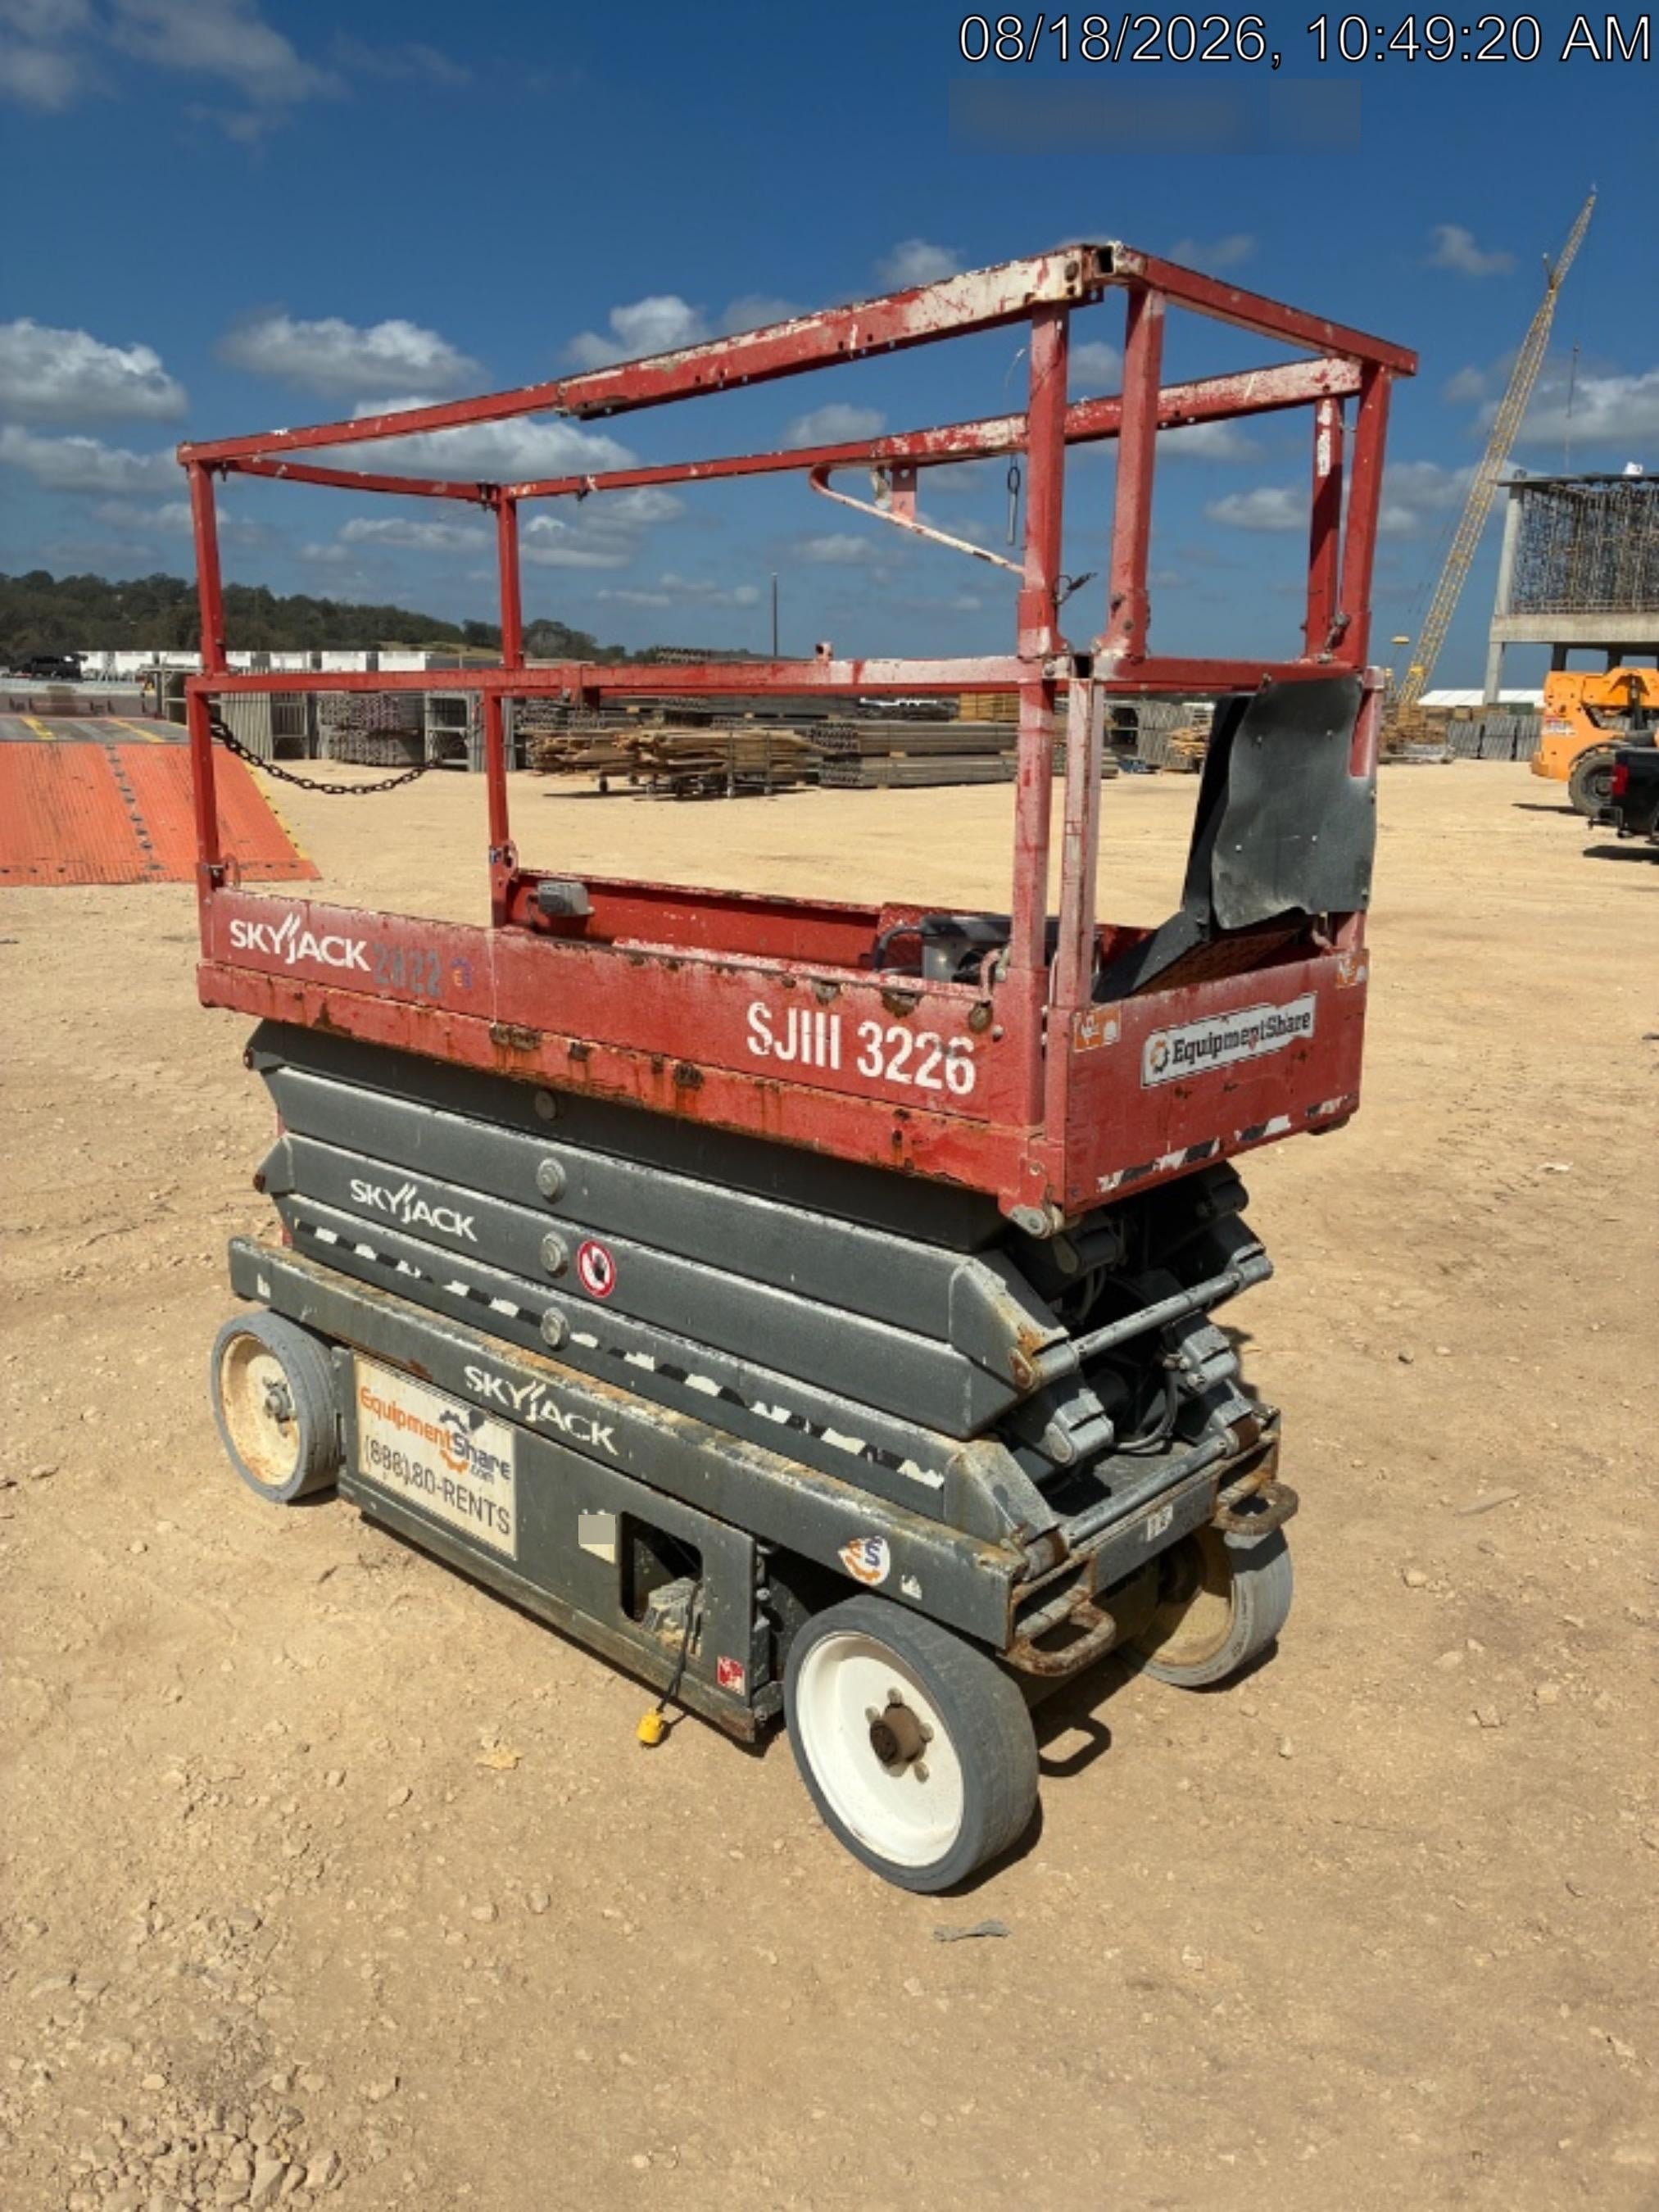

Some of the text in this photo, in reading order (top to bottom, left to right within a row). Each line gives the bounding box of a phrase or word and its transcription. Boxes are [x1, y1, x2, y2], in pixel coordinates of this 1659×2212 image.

[229, 912, 371, 972] SKYJACK
[856, 1021, 977, 1095] 3226
[1172, 1011, 1311, 1064] EquipmentShare
[350, 1178, 478, 1243] SKYJACK
[464, 1365, 619, 1457] SKYJACK
